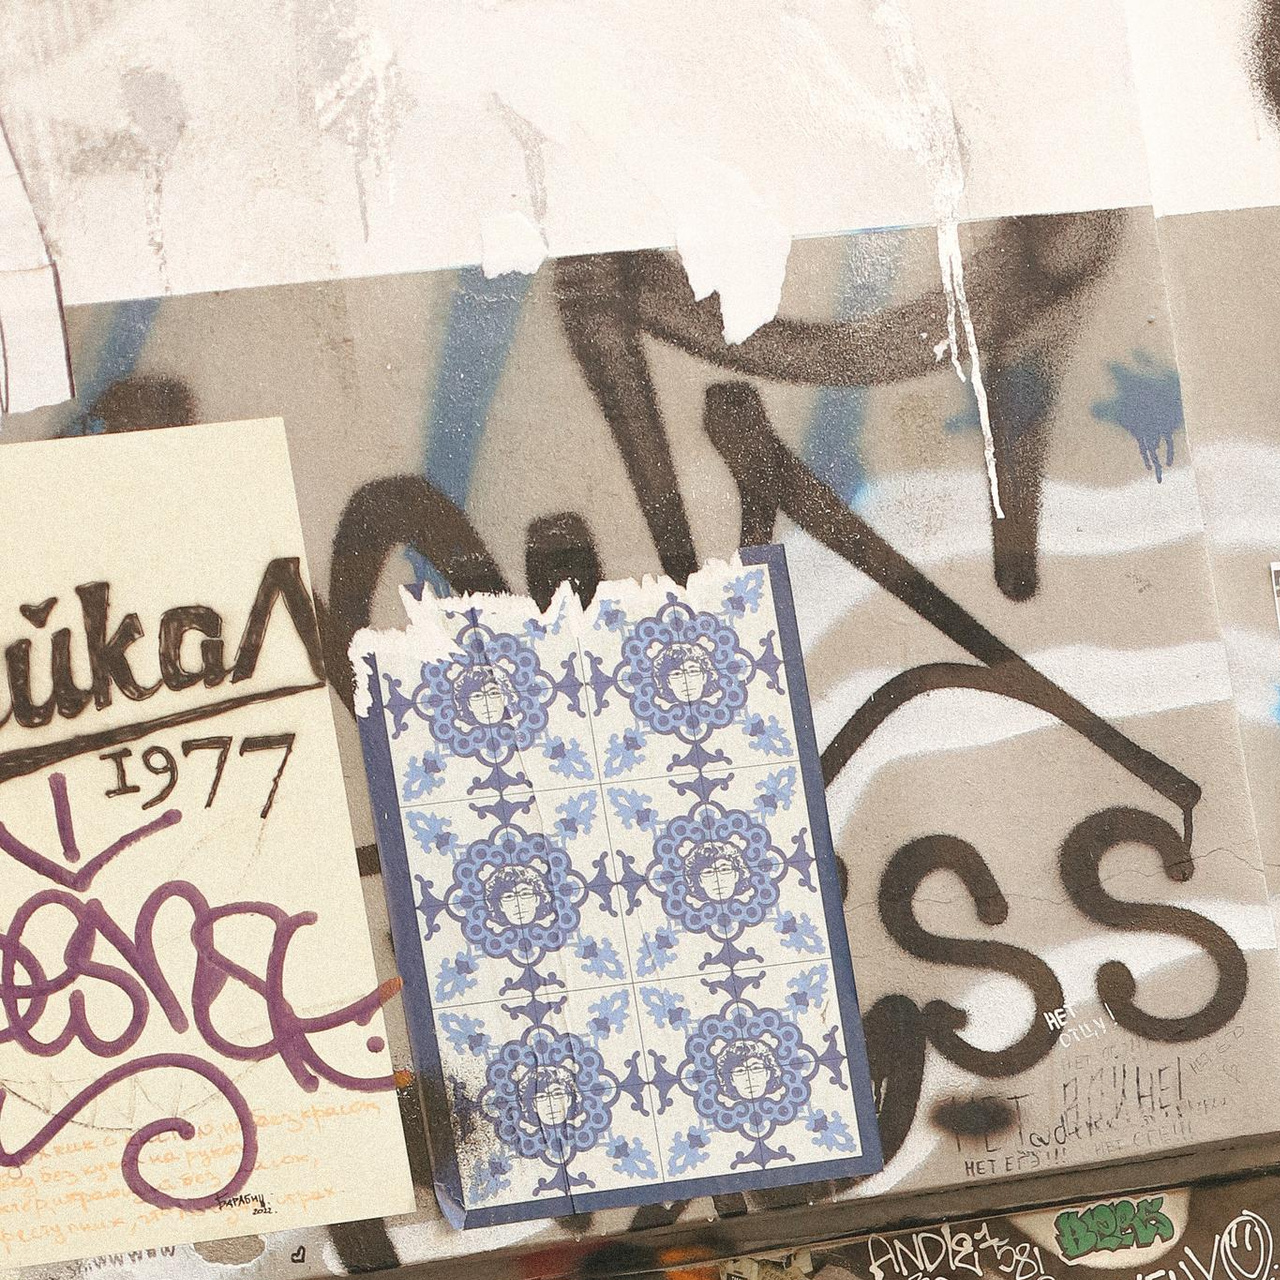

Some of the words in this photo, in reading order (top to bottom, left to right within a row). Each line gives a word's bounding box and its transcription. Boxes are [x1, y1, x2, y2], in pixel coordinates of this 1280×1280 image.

[100, 733, 296, 818] 1977
[1043, 1004, 1076, 1031] НЕТ
[965, 1160, 997, 1178] НЕТ
